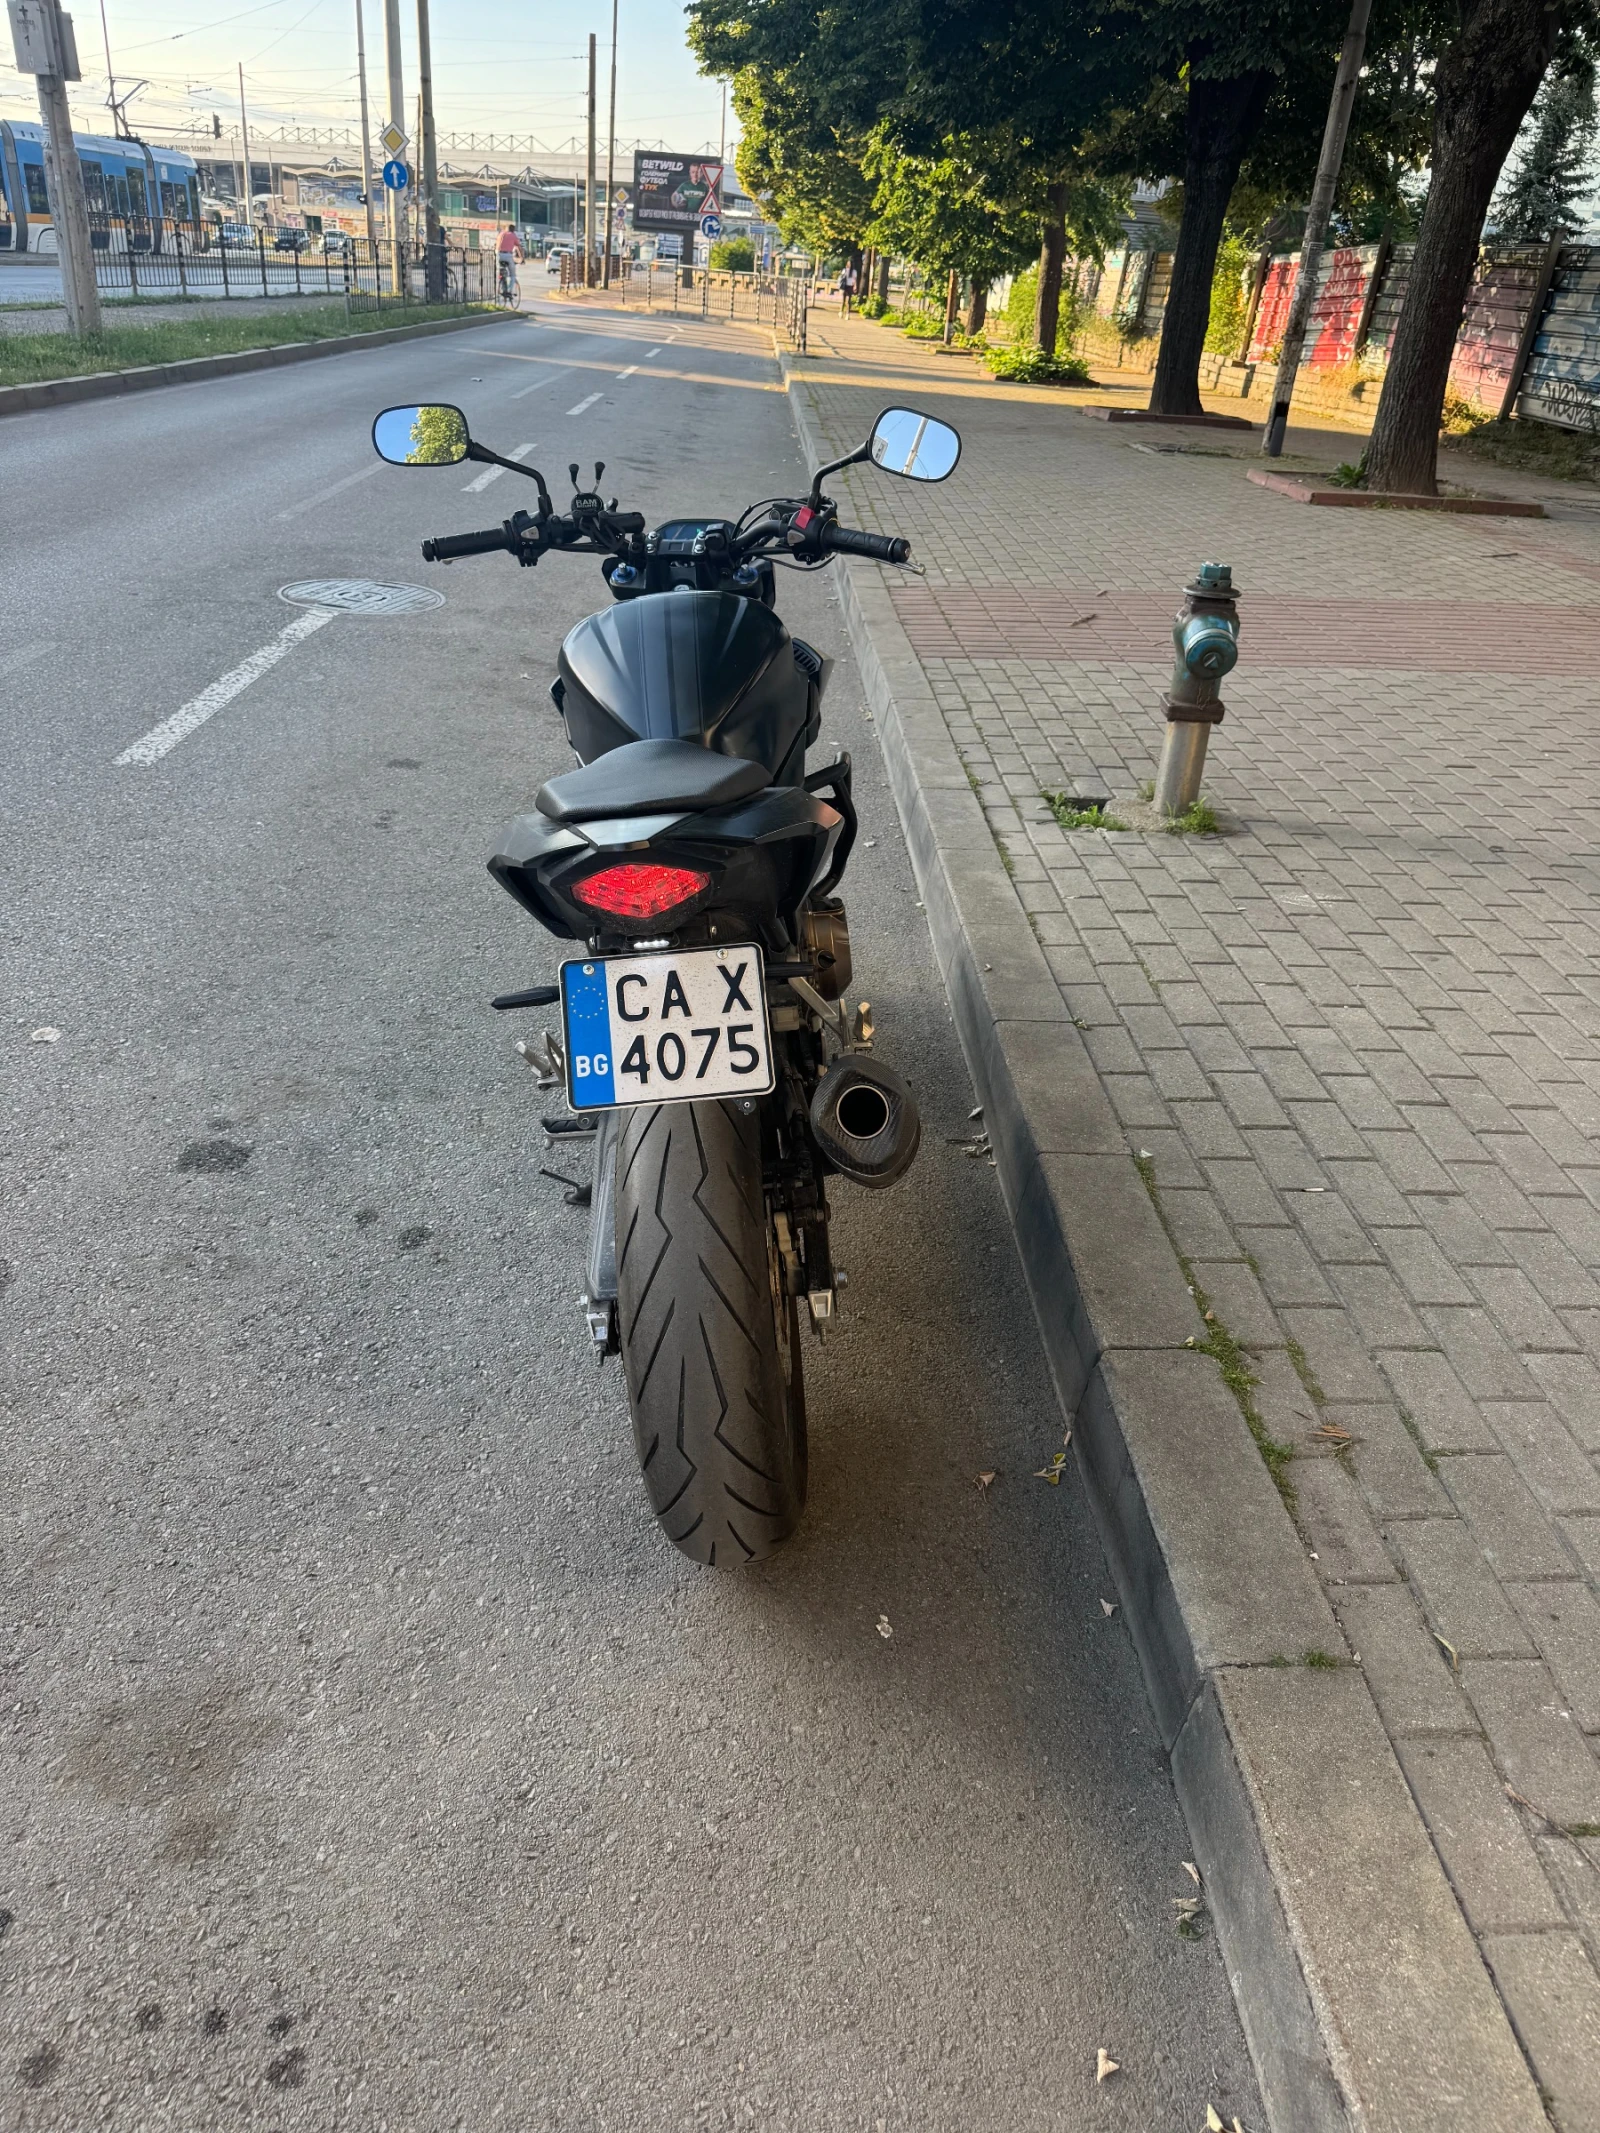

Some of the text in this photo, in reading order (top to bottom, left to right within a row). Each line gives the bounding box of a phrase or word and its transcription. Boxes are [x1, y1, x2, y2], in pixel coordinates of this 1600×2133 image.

[642, 159, 684, 171] BETWILD
[615, 962, 753, 1022] CA X
[575, 1054, 609, 1078] BG
[620, 1024, 760, 1084] 4075
